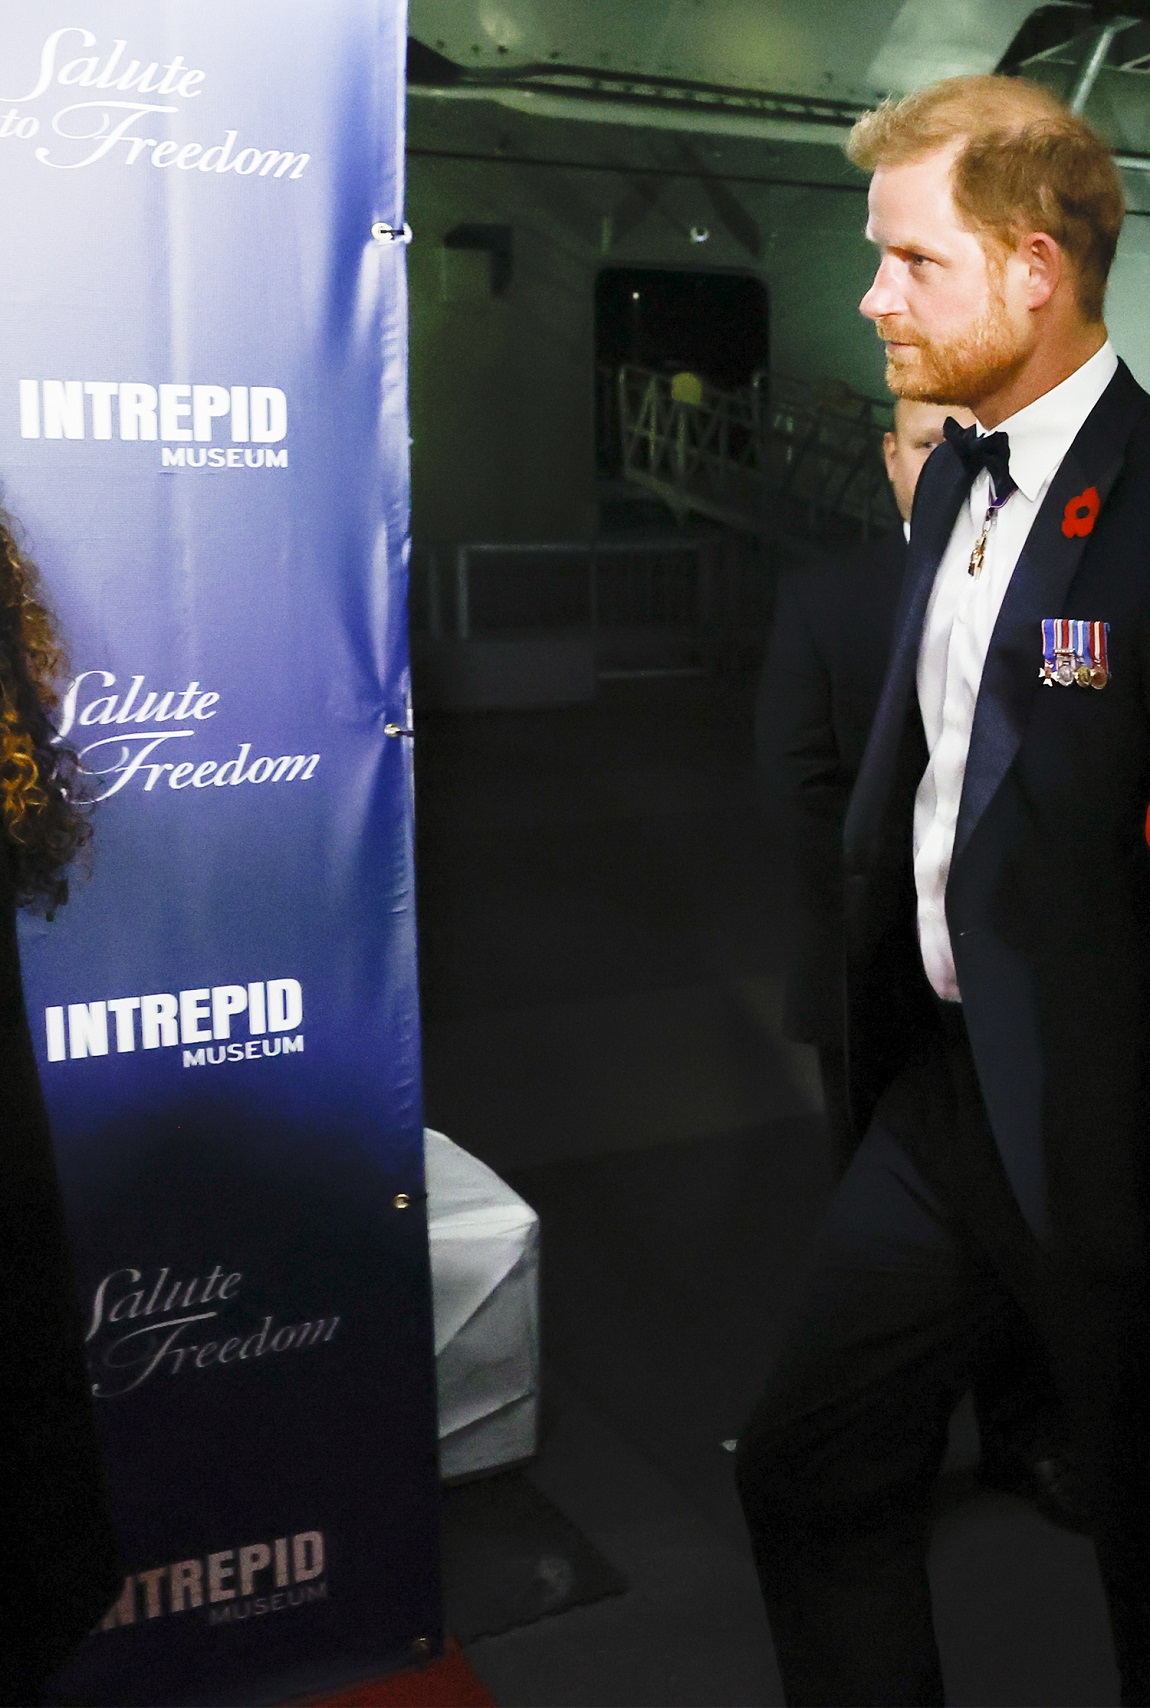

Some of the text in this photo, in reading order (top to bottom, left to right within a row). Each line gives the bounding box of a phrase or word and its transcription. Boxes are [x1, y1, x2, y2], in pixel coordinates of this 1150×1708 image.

[0, 27, 207, 101] Salute
[0, 100, 311, 180] to Freedom
[19, 379, 288, 443] INTREPID
[161, 447, 288, 468] MUSEUM
[50, 670, 220, 744] Salute
[60, 730, 321, 805] Freedom
[45, 978, 304, 1063] INTREPID
[183, 1035, 304, 1068] MUSEUM
[84, 1265, 242, 1343] Salute
[91, 1311, 341, 1398] Freedom
[88, 1530, 325, 1637] NTREPID
[208, 1582, 327, 1626] MUSEUM
